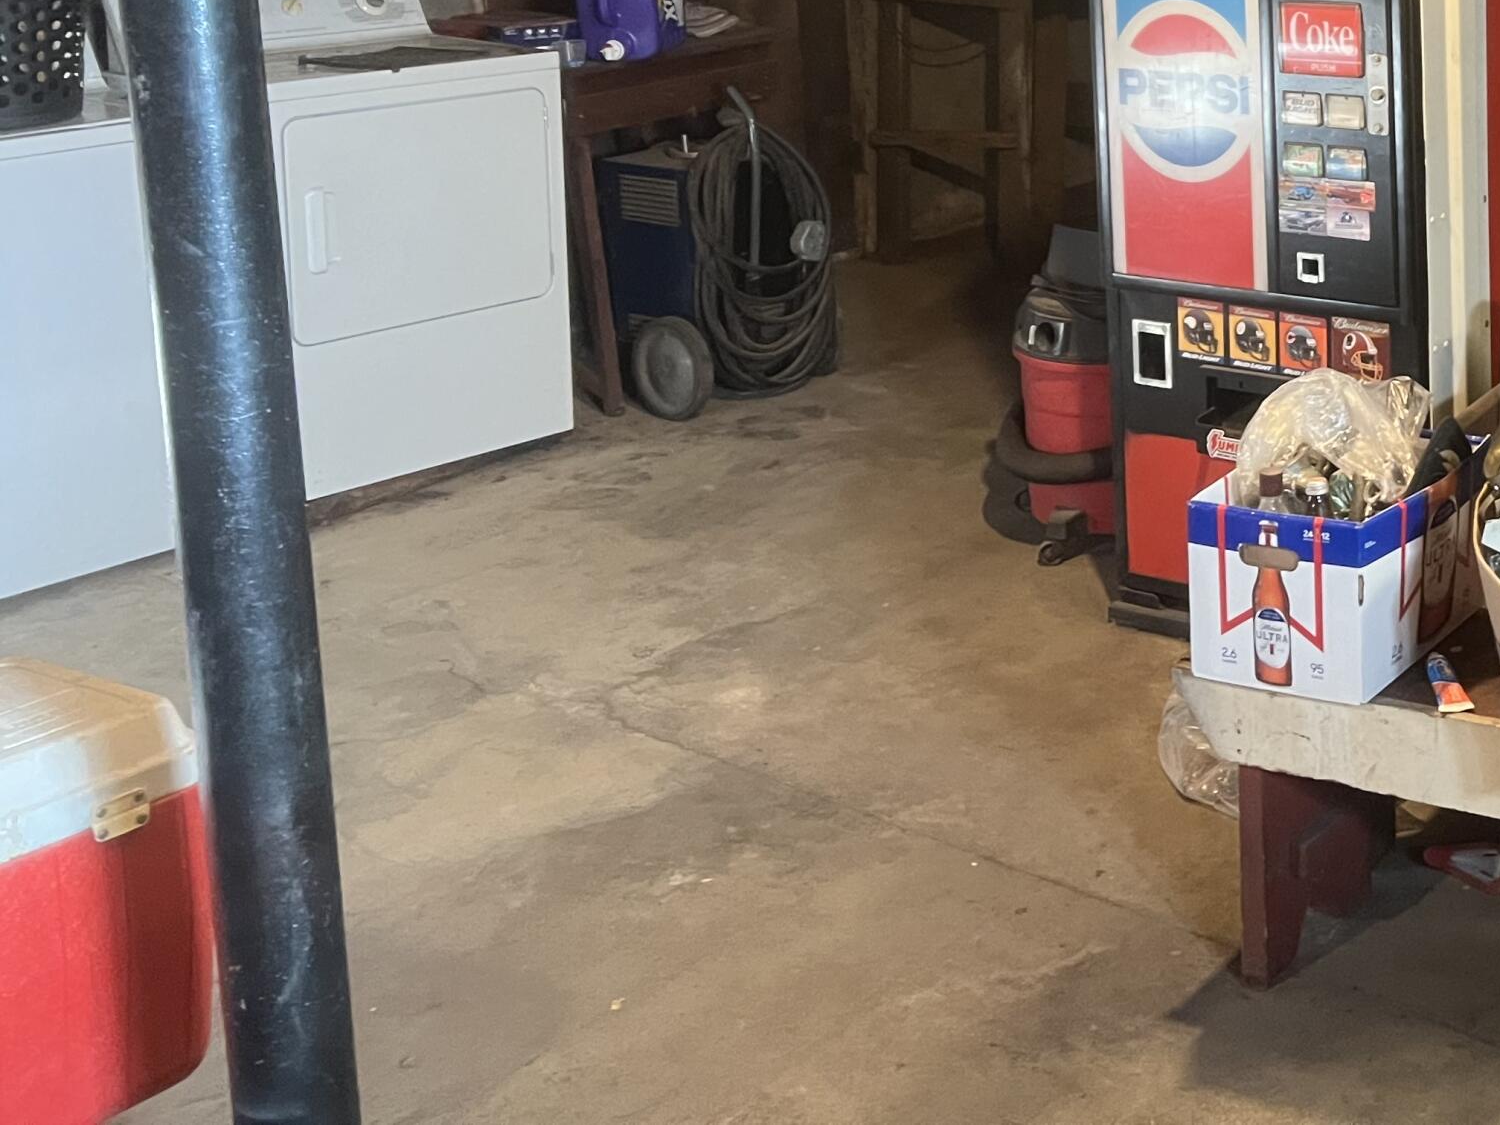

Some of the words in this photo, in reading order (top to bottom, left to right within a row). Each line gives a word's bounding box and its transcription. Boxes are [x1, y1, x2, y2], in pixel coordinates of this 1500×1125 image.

[1289, 11, 1357, 57] Coke
[1118, 68, 1250, 115] PEPSI
[1255, 631, 1288, 643] ULTRA
[1221, 646, 1238, 659] 2.6
[1310, 662, 1325, 675] 95
